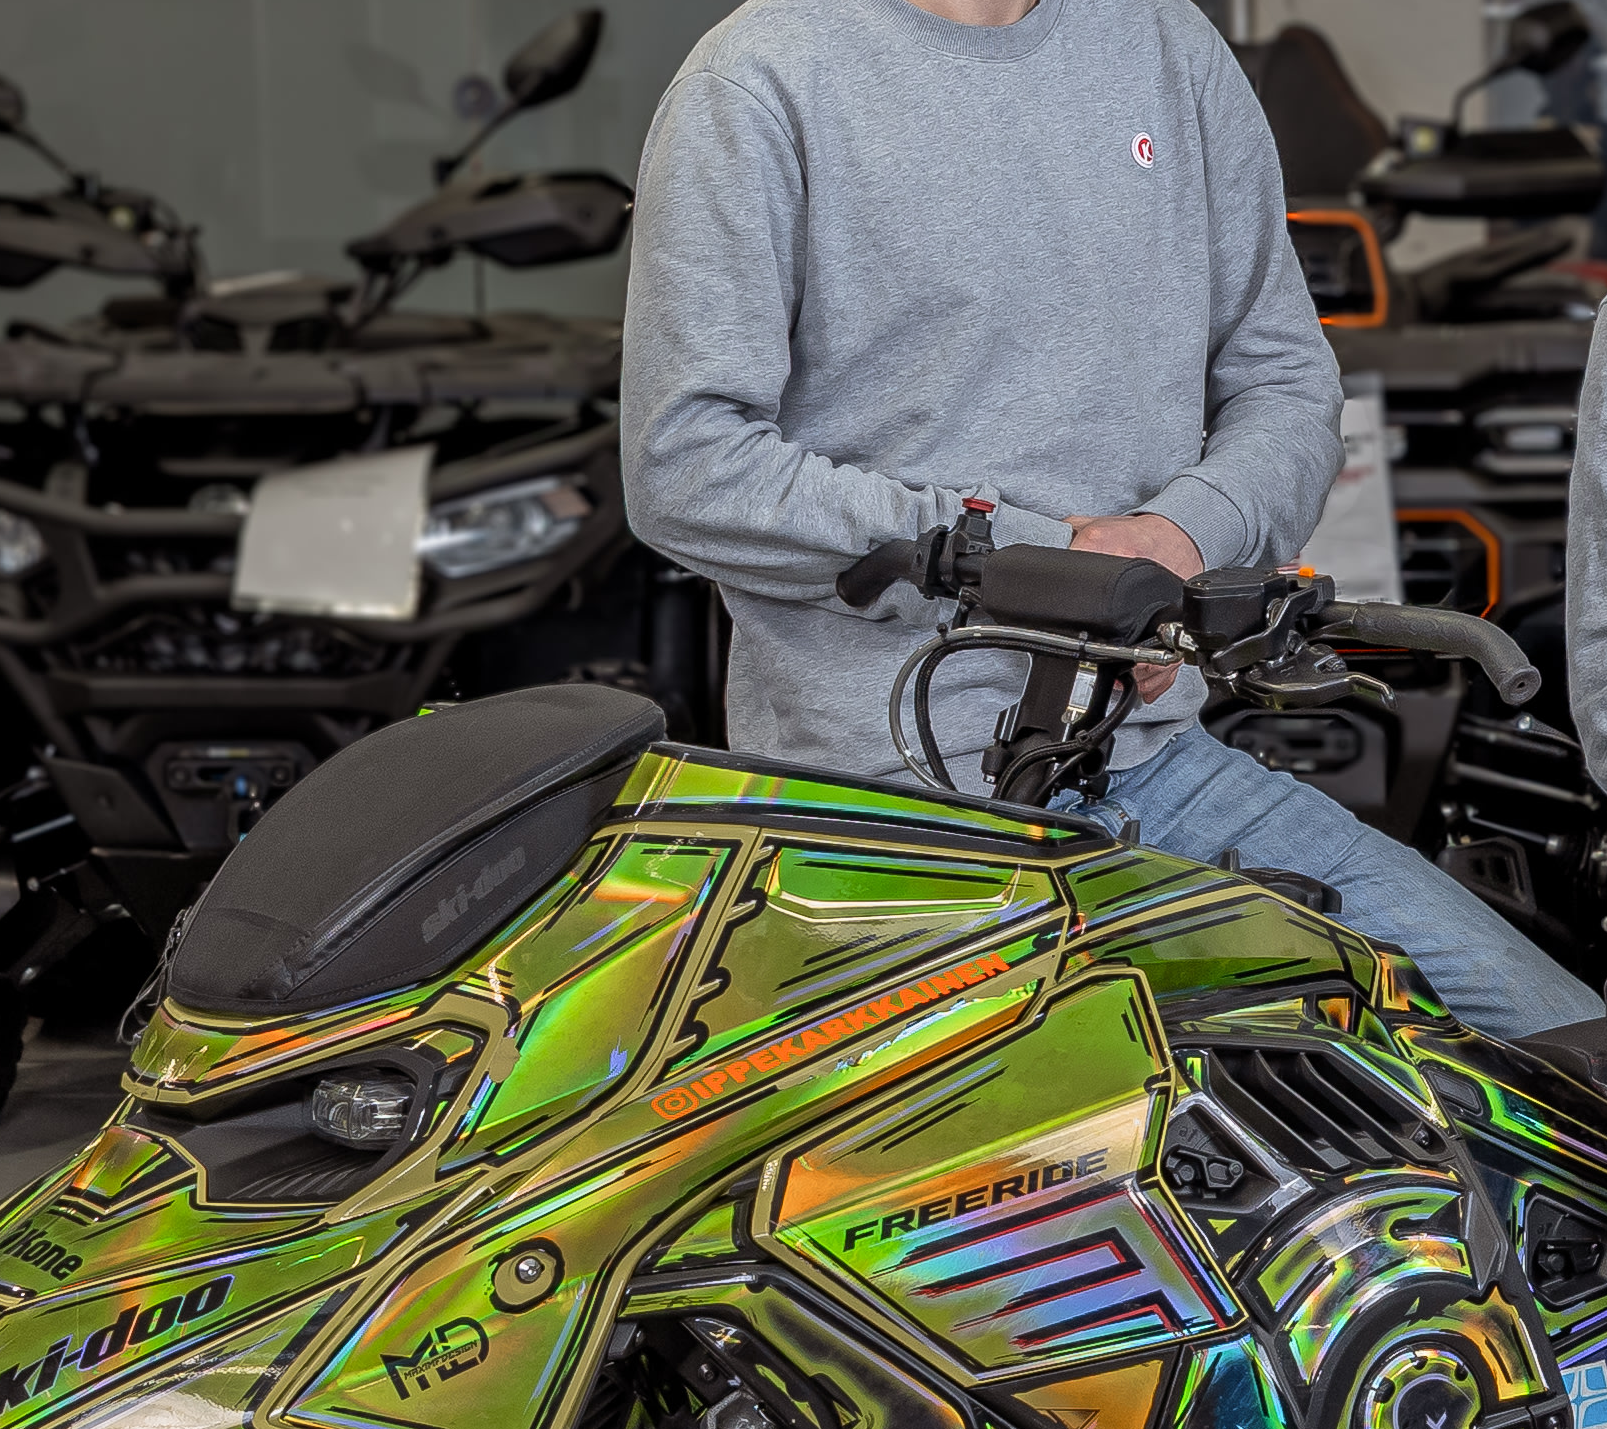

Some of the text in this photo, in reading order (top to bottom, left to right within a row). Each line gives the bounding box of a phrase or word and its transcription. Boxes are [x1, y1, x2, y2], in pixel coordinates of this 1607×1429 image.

[691, 953, 1010, 1100] IPPEKARKKAINEN
[842, 1148, 1109, 1253] FREERIDE
[17, 1227, 84, 1281] Kone
